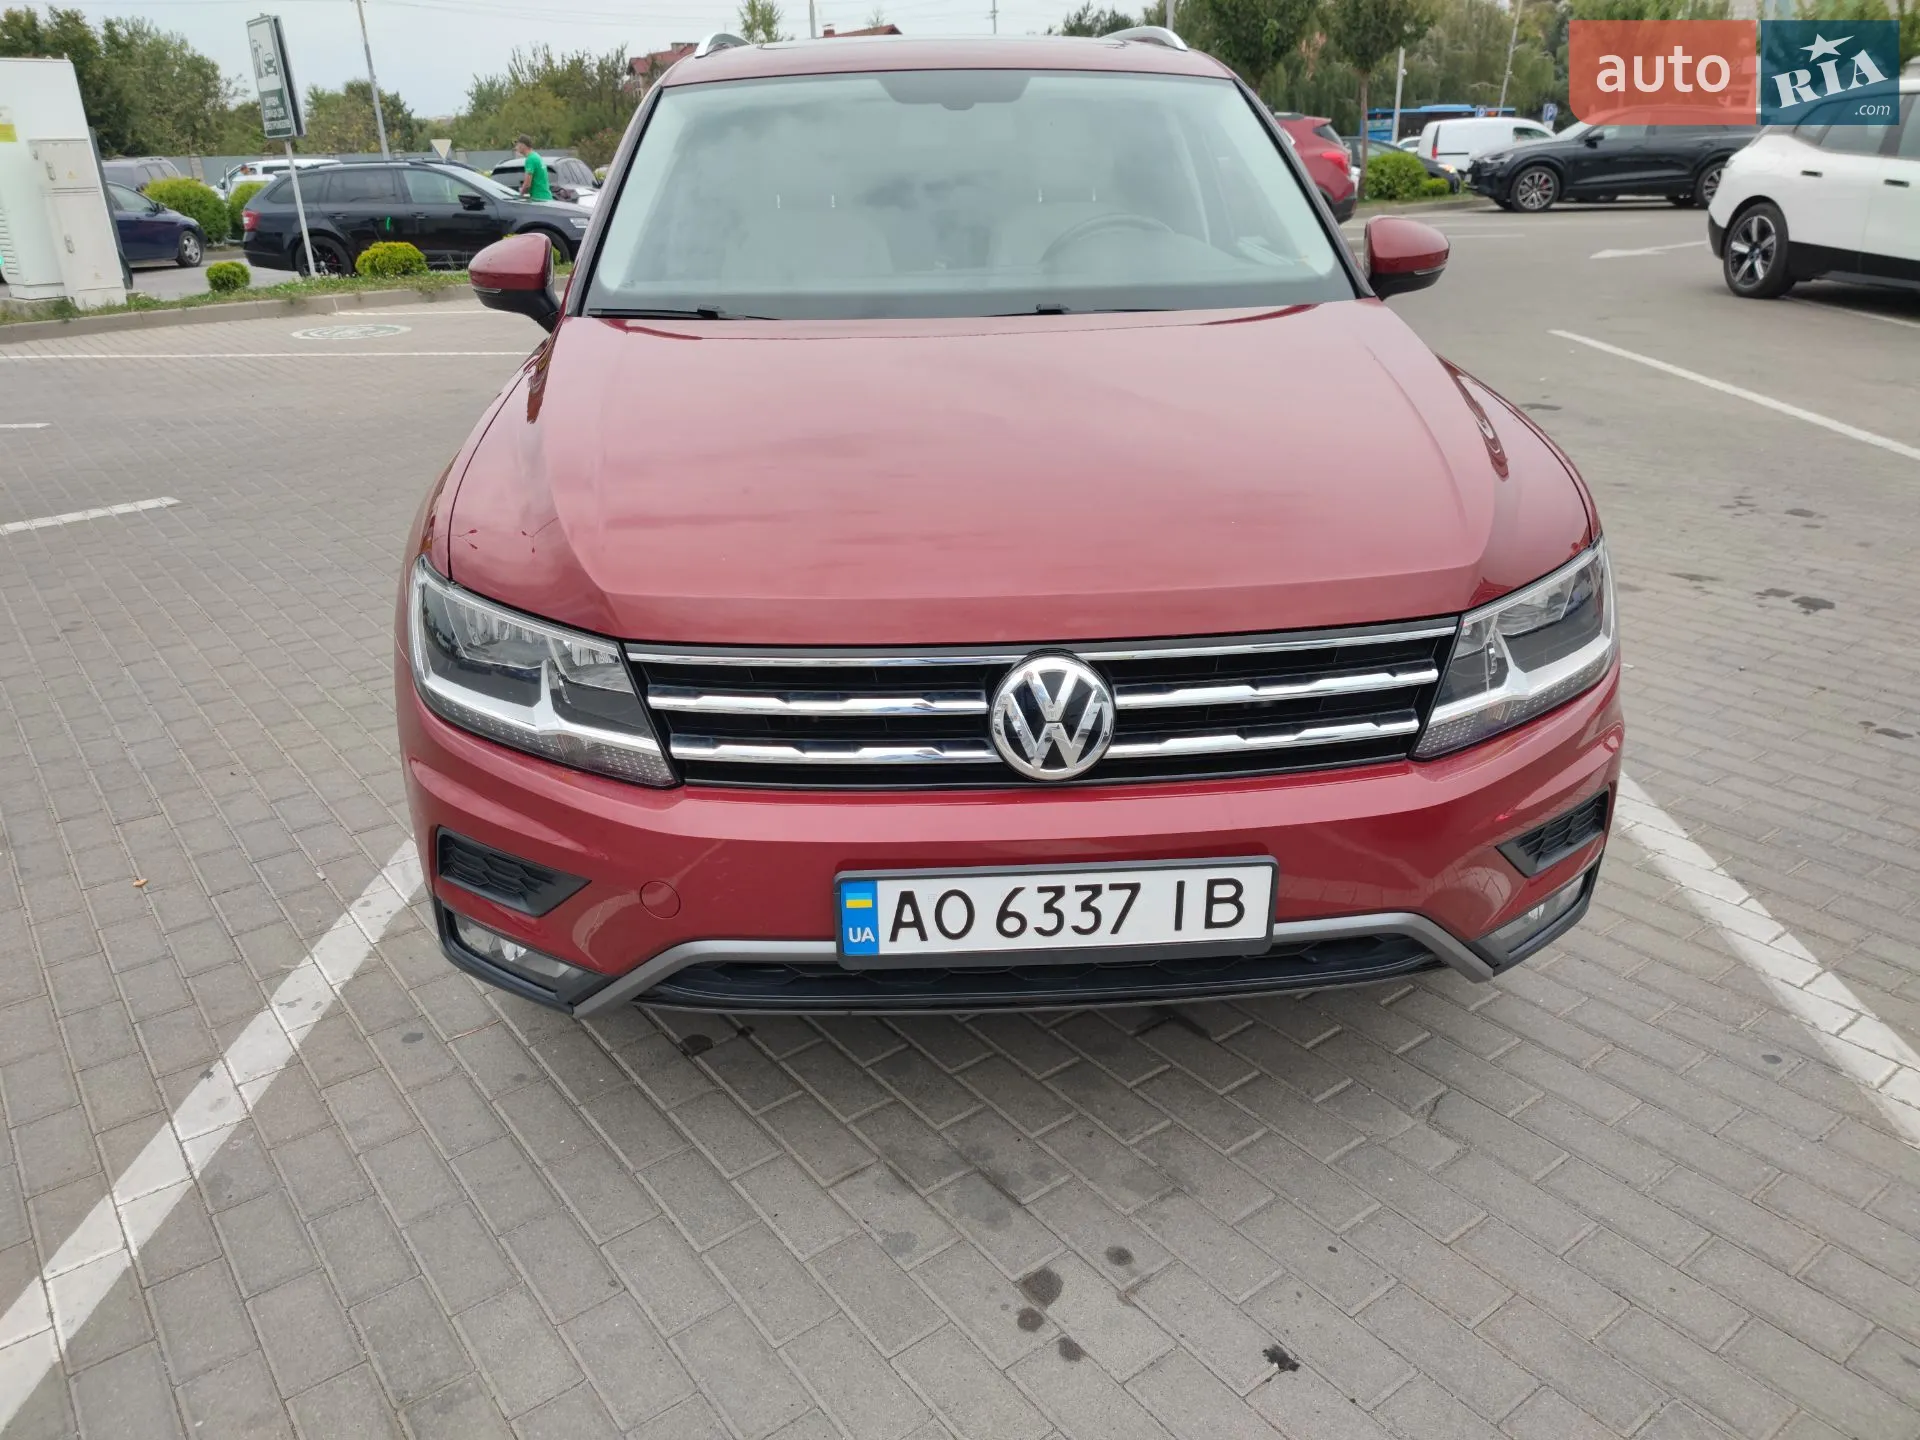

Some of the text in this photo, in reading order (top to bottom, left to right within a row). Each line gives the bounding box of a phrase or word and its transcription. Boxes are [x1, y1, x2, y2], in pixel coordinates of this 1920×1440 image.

[998, 666, 1105, 772] VW
[848, 927, 876, 943] UA
[888, 877, 1246, 943] AO 6337 IB
